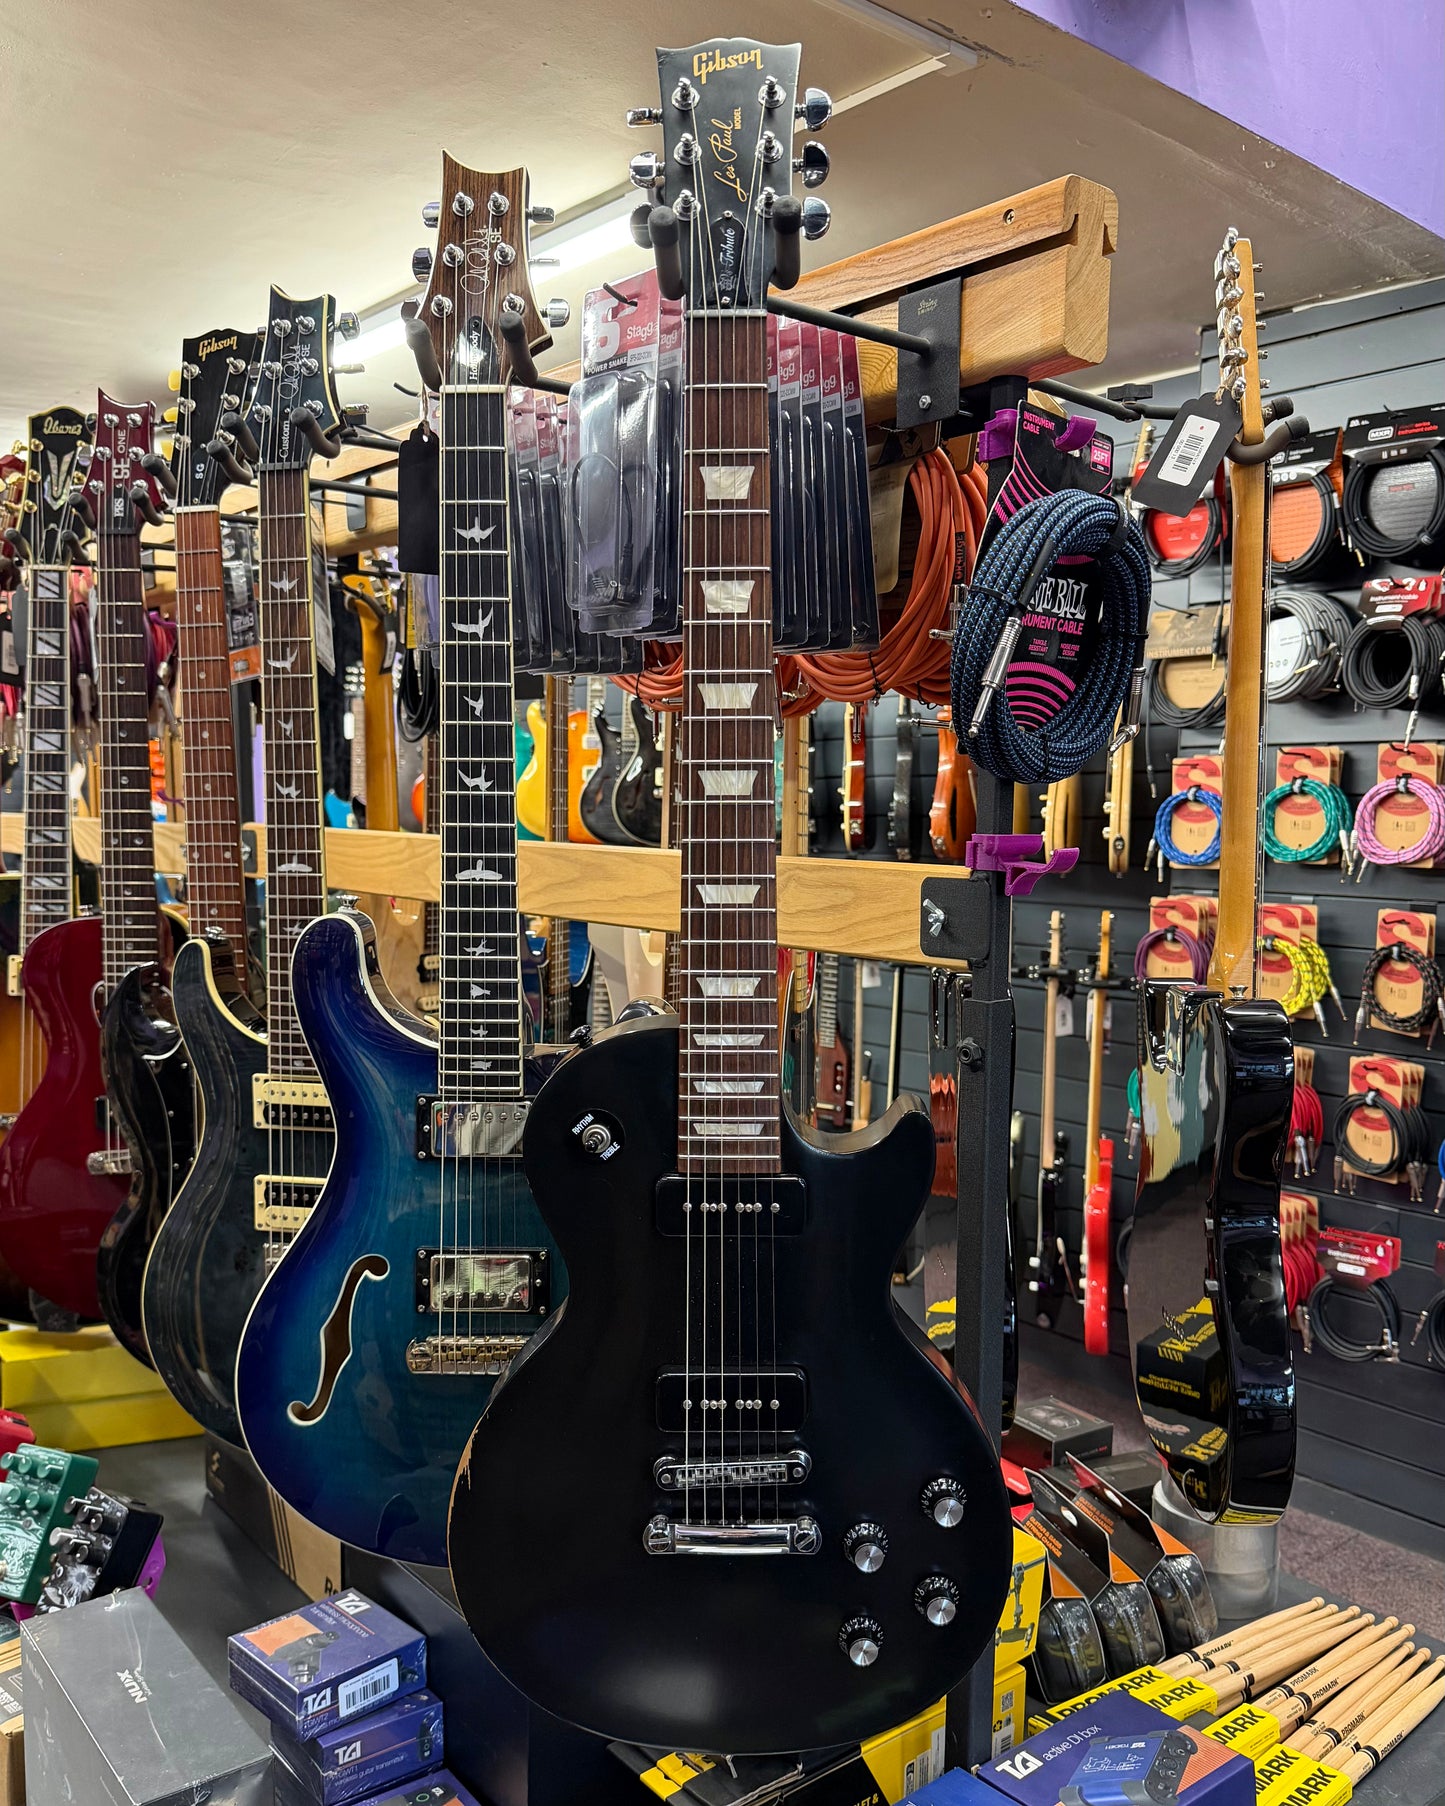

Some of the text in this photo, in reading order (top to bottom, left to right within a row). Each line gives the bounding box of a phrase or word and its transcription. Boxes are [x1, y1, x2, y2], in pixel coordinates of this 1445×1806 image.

[693, 48, 764, 84] Gibson
[708, 118, 738, 163] Paul
[490, 226, 502, 243] SE
[719, 227, 736, 266] Tribute
[626, 321, 654, 341] Stagg
[198, 335, 238, 361] Gibson
[302, 343, 311, 357] SE
[608, 356, 627, 369] SNAKE
[43, 416, 83, 436] Ibanez
[1022, 421, 1040, 434] CABLE
[1023, 411, 1055, 430] INSTRUMENT
[1369, 427, 1392, 439] MXR
[279, 420, 290, 459] Custom
[112, 429, 131, 479] SE ONE
[1093, 450, 1109, 464] 25FT
[195, 463, 205, 480] SG
[113, 498, 125, 518] PRS
[1051, 578, 1089, 621] BALL
[1021, 613, 1084, 636] RUMENT CABLE
[1146, 647, 1194, 658] INSTRUMENT
[571, 1113, 594, 1135] RHYTHM
[600, 1141, 620, 1160] TREBLE
[1074, 1499, 1114, 1535] STRING CHANGE
[1024, 1520, 1063, 1558] STRING CHANGE
[1028, 1515, 1047, 1533] GUITAR
[1047, 1534, 1063, 1549] BASS
[1290, 1666, 1319, 1687] PROMARK
[1311, 1677, 1340, 1701] PROMARK
[1150, 1680, 1204, 1710] MARK
[1211, 1708, 1267, 1746] MARK
[1340, 1711, 1366, 1737] PROMARK
[334, 1740, 362, 1765] TGI
[1043, 1724, 1102, 1761] active DI box
[1380, 1732, 1404, 1757] PROMARK
[995, 1751, 1043, 1780] TGI
[1256, 1749, 1300, 1795] MARK
